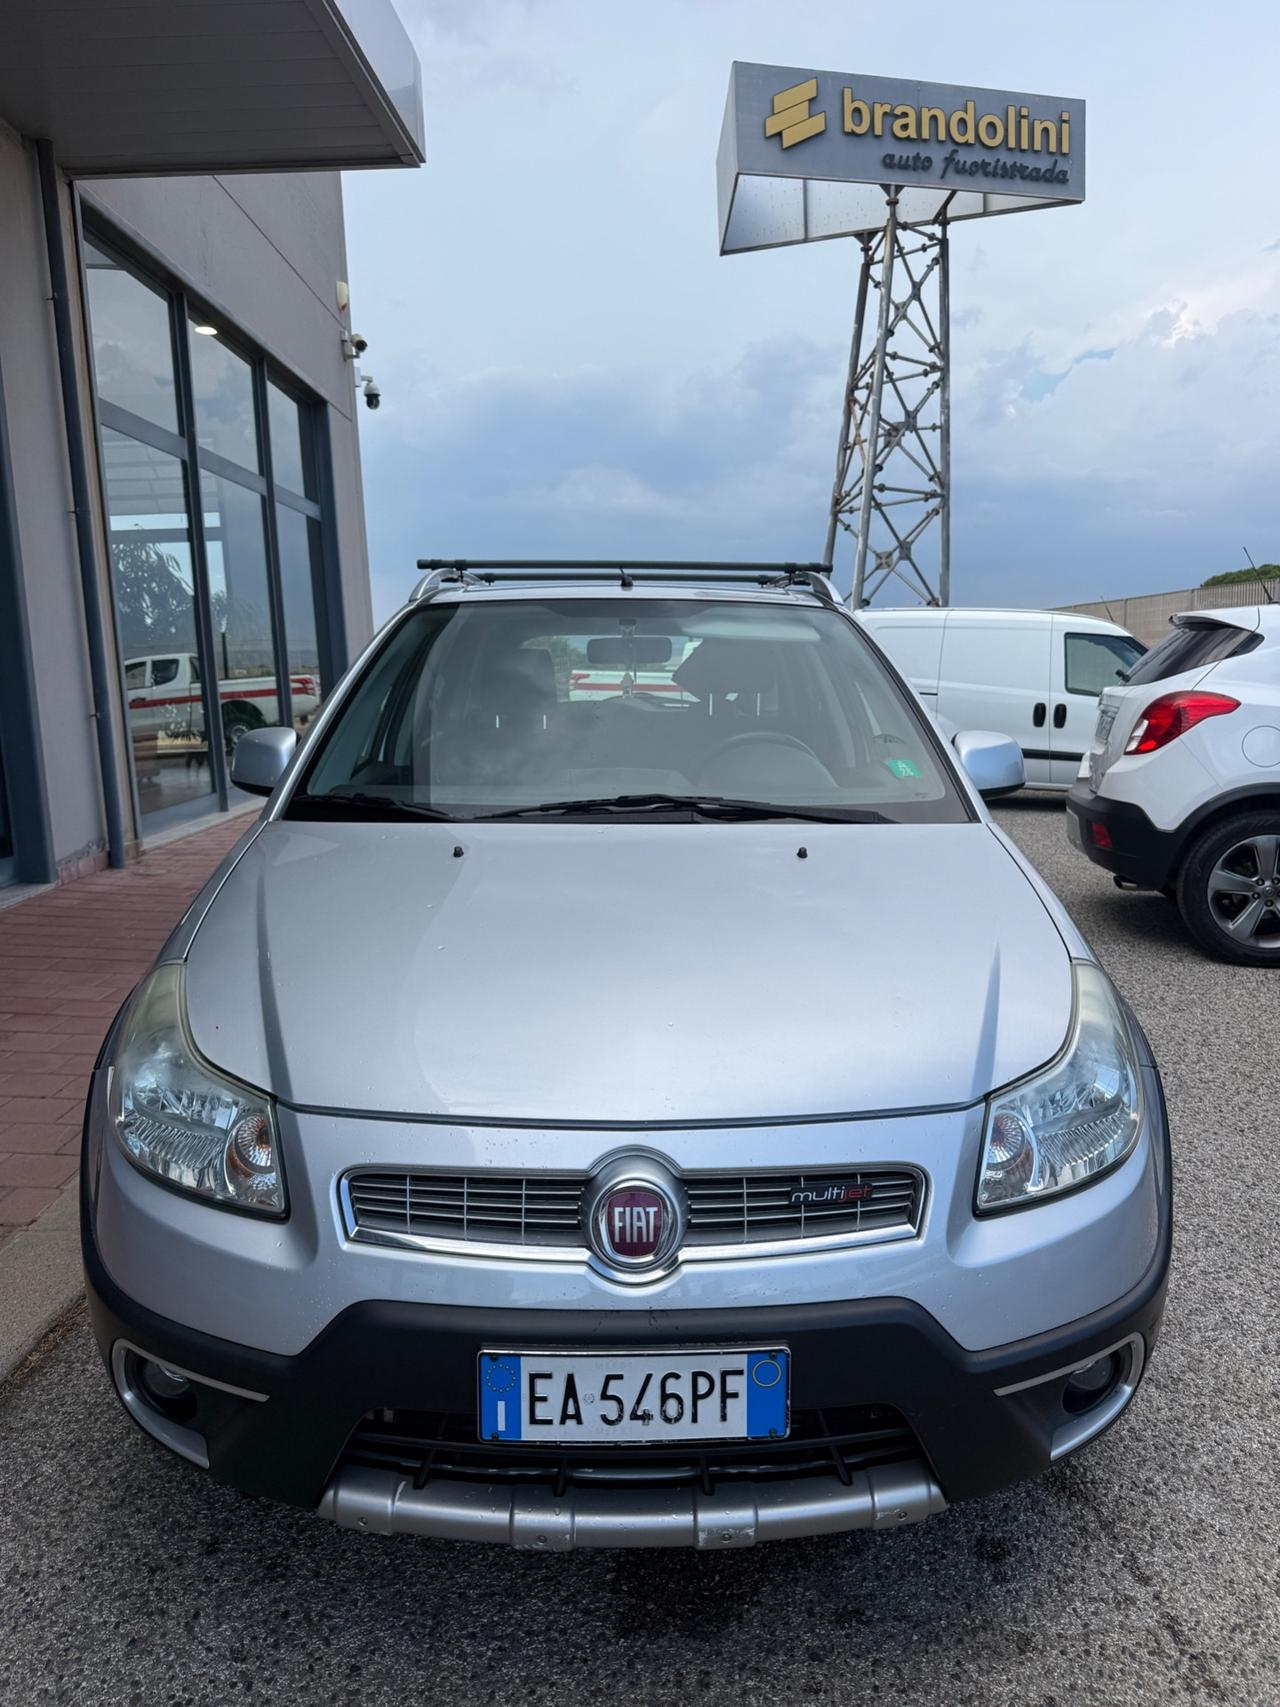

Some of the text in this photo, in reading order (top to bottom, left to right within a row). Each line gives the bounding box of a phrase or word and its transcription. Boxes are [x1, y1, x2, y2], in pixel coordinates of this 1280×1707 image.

[841, 86, 1071, 155] brandolini
[881, 149, 1069, 184] auto fuoristrada
[791, 1184, 873, 1204] multijet
[613, 1206, 658, 1244] FIAT
